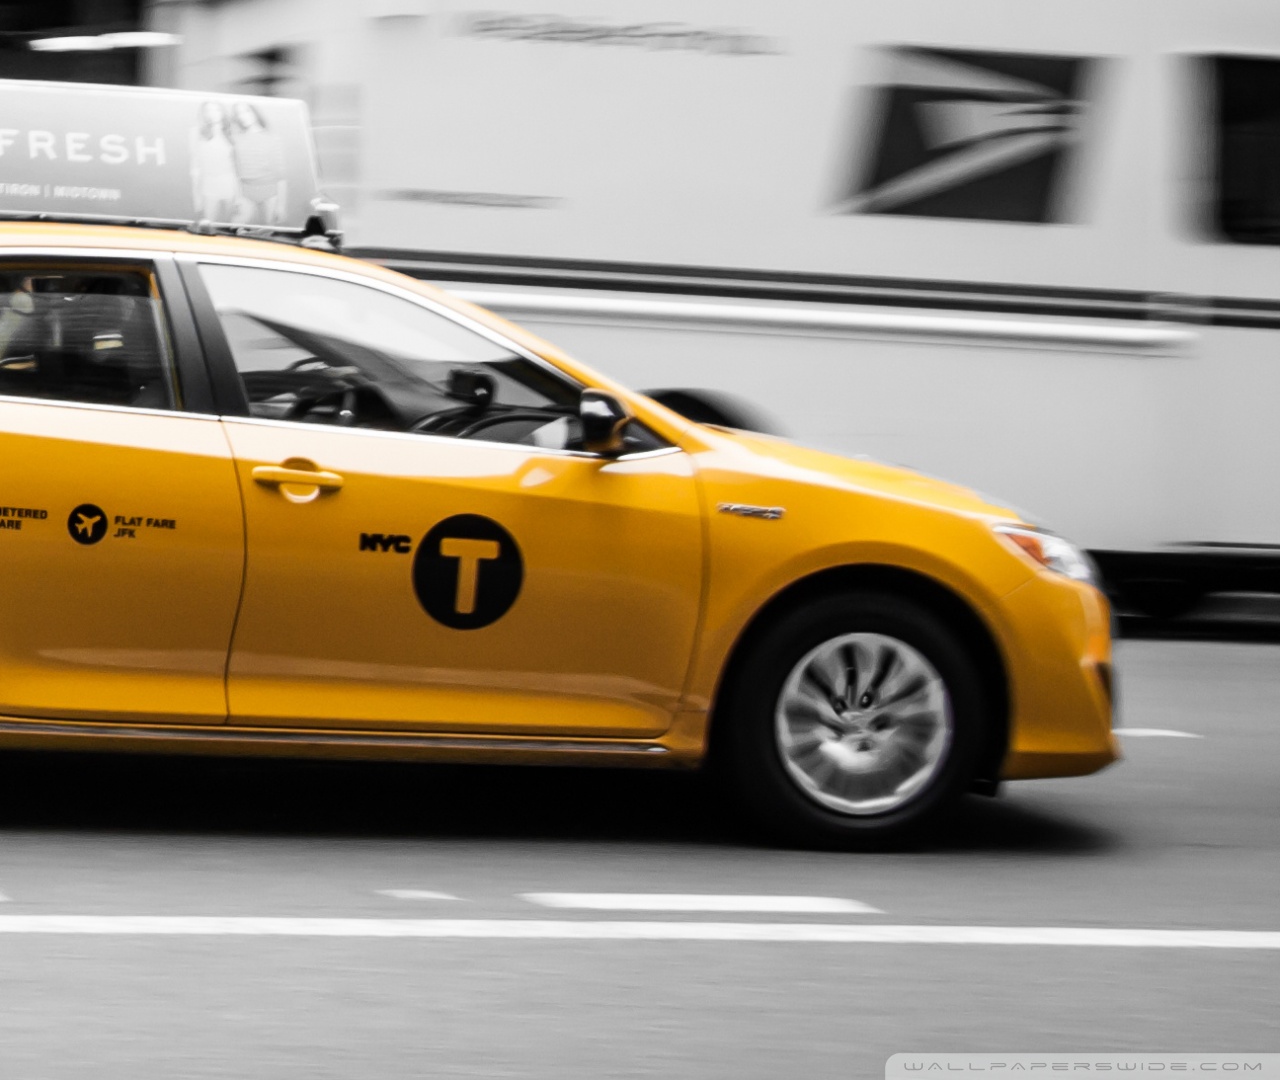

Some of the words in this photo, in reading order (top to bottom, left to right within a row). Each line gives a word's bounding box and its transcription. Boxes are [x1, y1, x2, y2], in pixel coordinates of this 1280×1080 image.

[53, 185, 122, 201] MIDTOWN
[114, 515, 143, 528] FLAT
[146, 517, 176, 530] FARE
[113, 527, 136, 539] JFK
[359, 533, 412, 554] NYC
[439, 537, 501, 615] T
